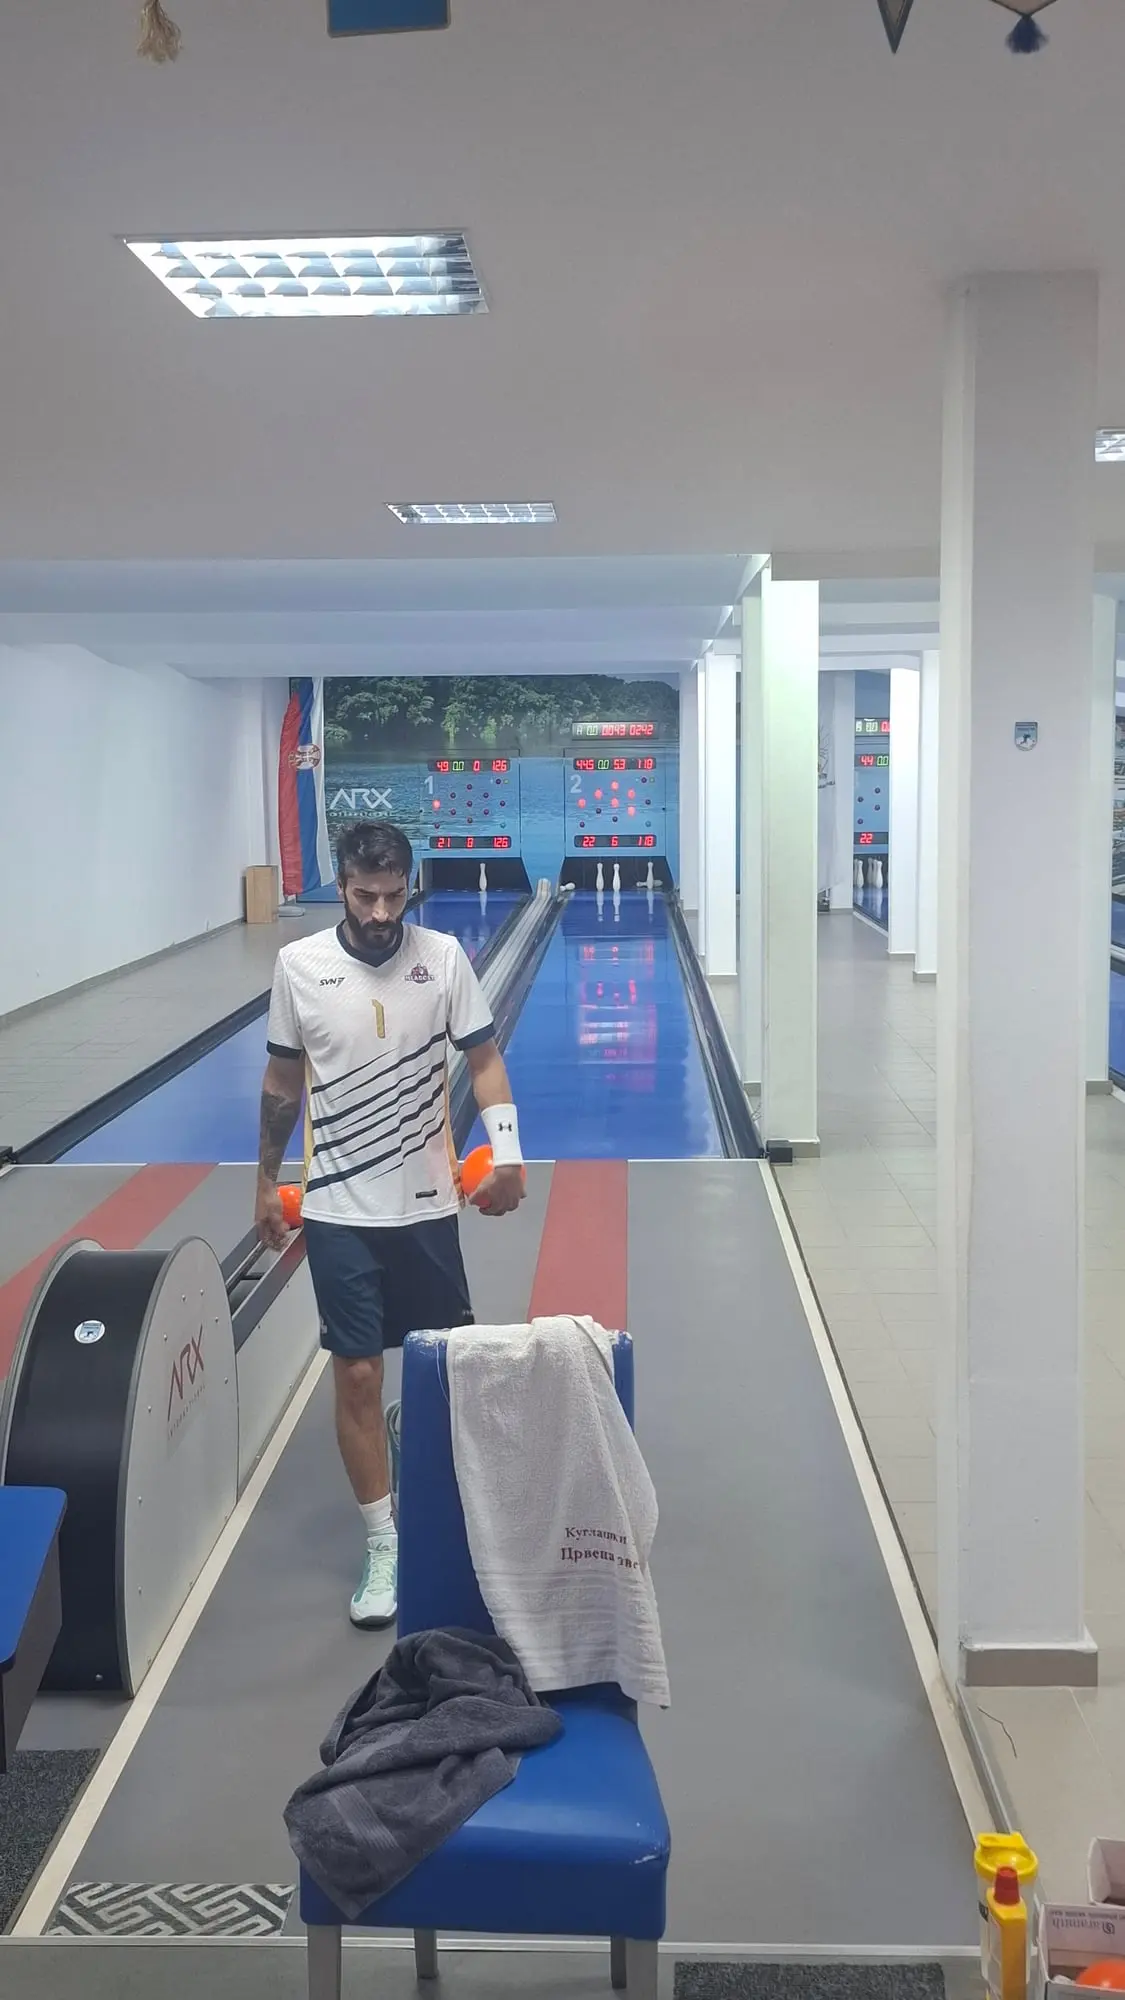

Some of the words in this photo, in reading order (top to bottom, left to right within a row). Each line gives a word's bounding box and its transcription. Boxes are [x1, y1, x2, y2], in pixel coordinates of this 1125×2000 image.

[473, 760, 480, 771] 0
[492, 759, 507, 771] 126
[424, 775, 434, 794] 1
[570, 775, 582, 793] 2
[329, 788, 392, 809] ARX
[493, 836, 508, 848] 126
[582, 836, 596, 847] 22
[611, 836, 618, 847] 6
[859, 833, 873, 844] 22
[371, 998, 386, 1040] 1
